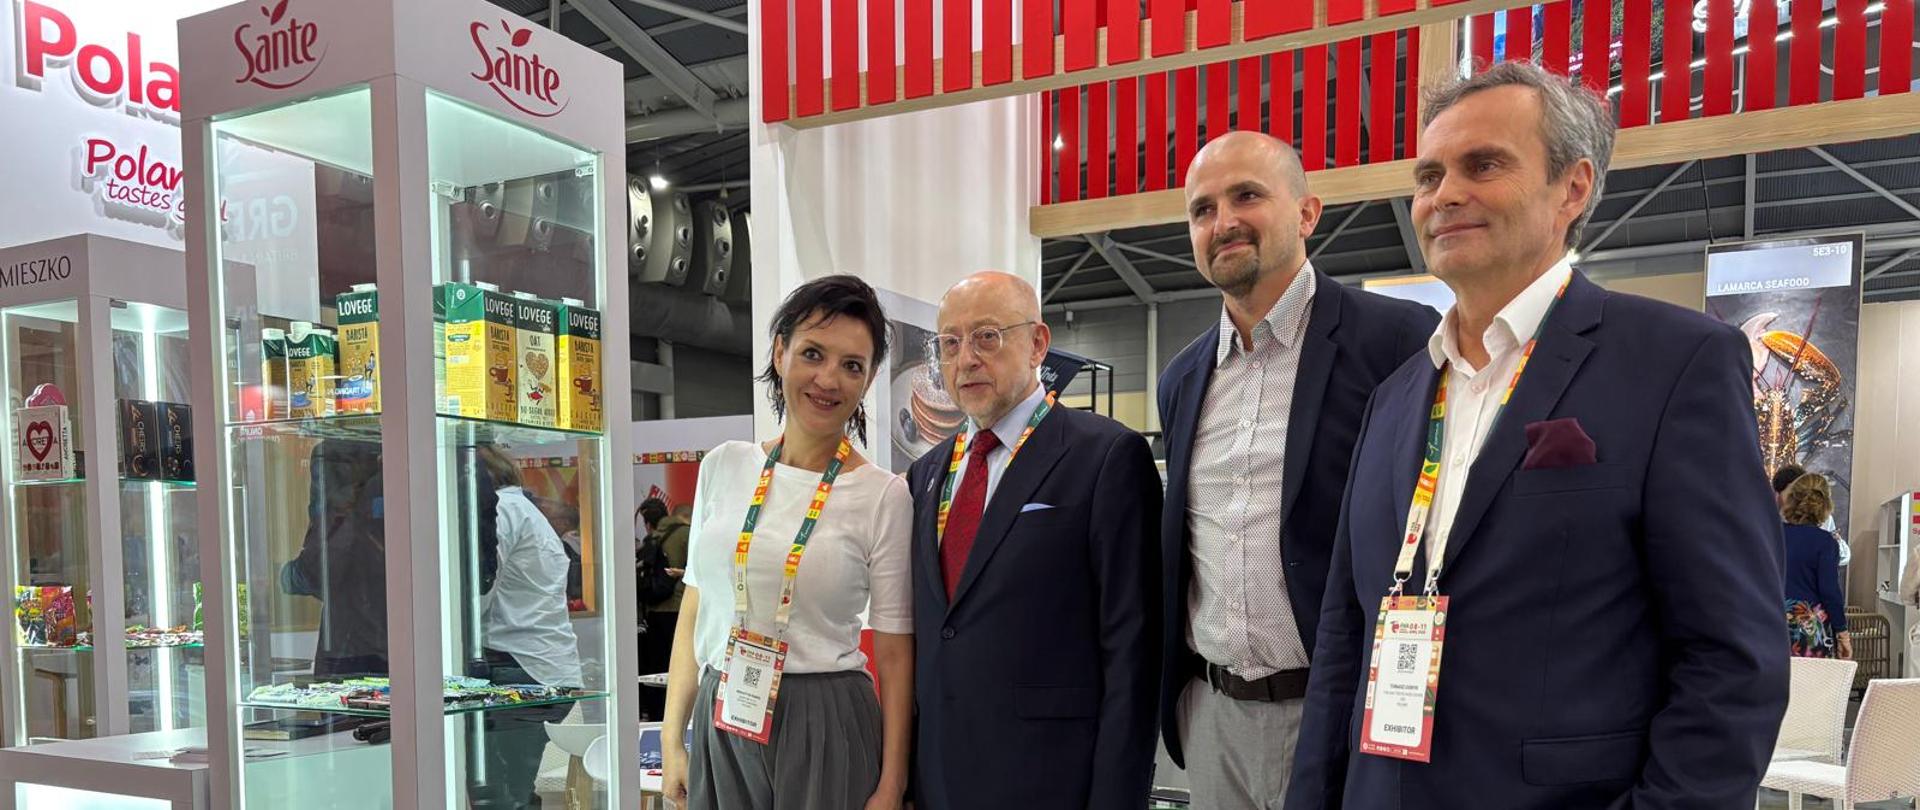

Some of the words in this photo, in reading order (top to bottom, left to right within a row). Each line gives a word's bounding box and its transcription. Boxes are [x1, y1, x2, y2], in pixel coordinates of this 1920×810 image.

[234, 19, 318, 83] Sante
[470, 21, 560, 106] Sante
[107, 178, 171, 210] tastes
[1813, 246, 1847, 257] SE3-10
[0, 255, 72, 288] MIESZKO
[1718, 281, 1764, 292] LAMARCA
[1765, 277, 1810, 290] SEAFOOD
[338, 298, 373, 316] LOVEGE
[485, 297, 514, 318] LOVEGE
[519, 305, 552, 325] LOVEGE
[569, 311, 599, 332] LOVEGE
[1384, 723, 1416, 735] EXHIBITOR
